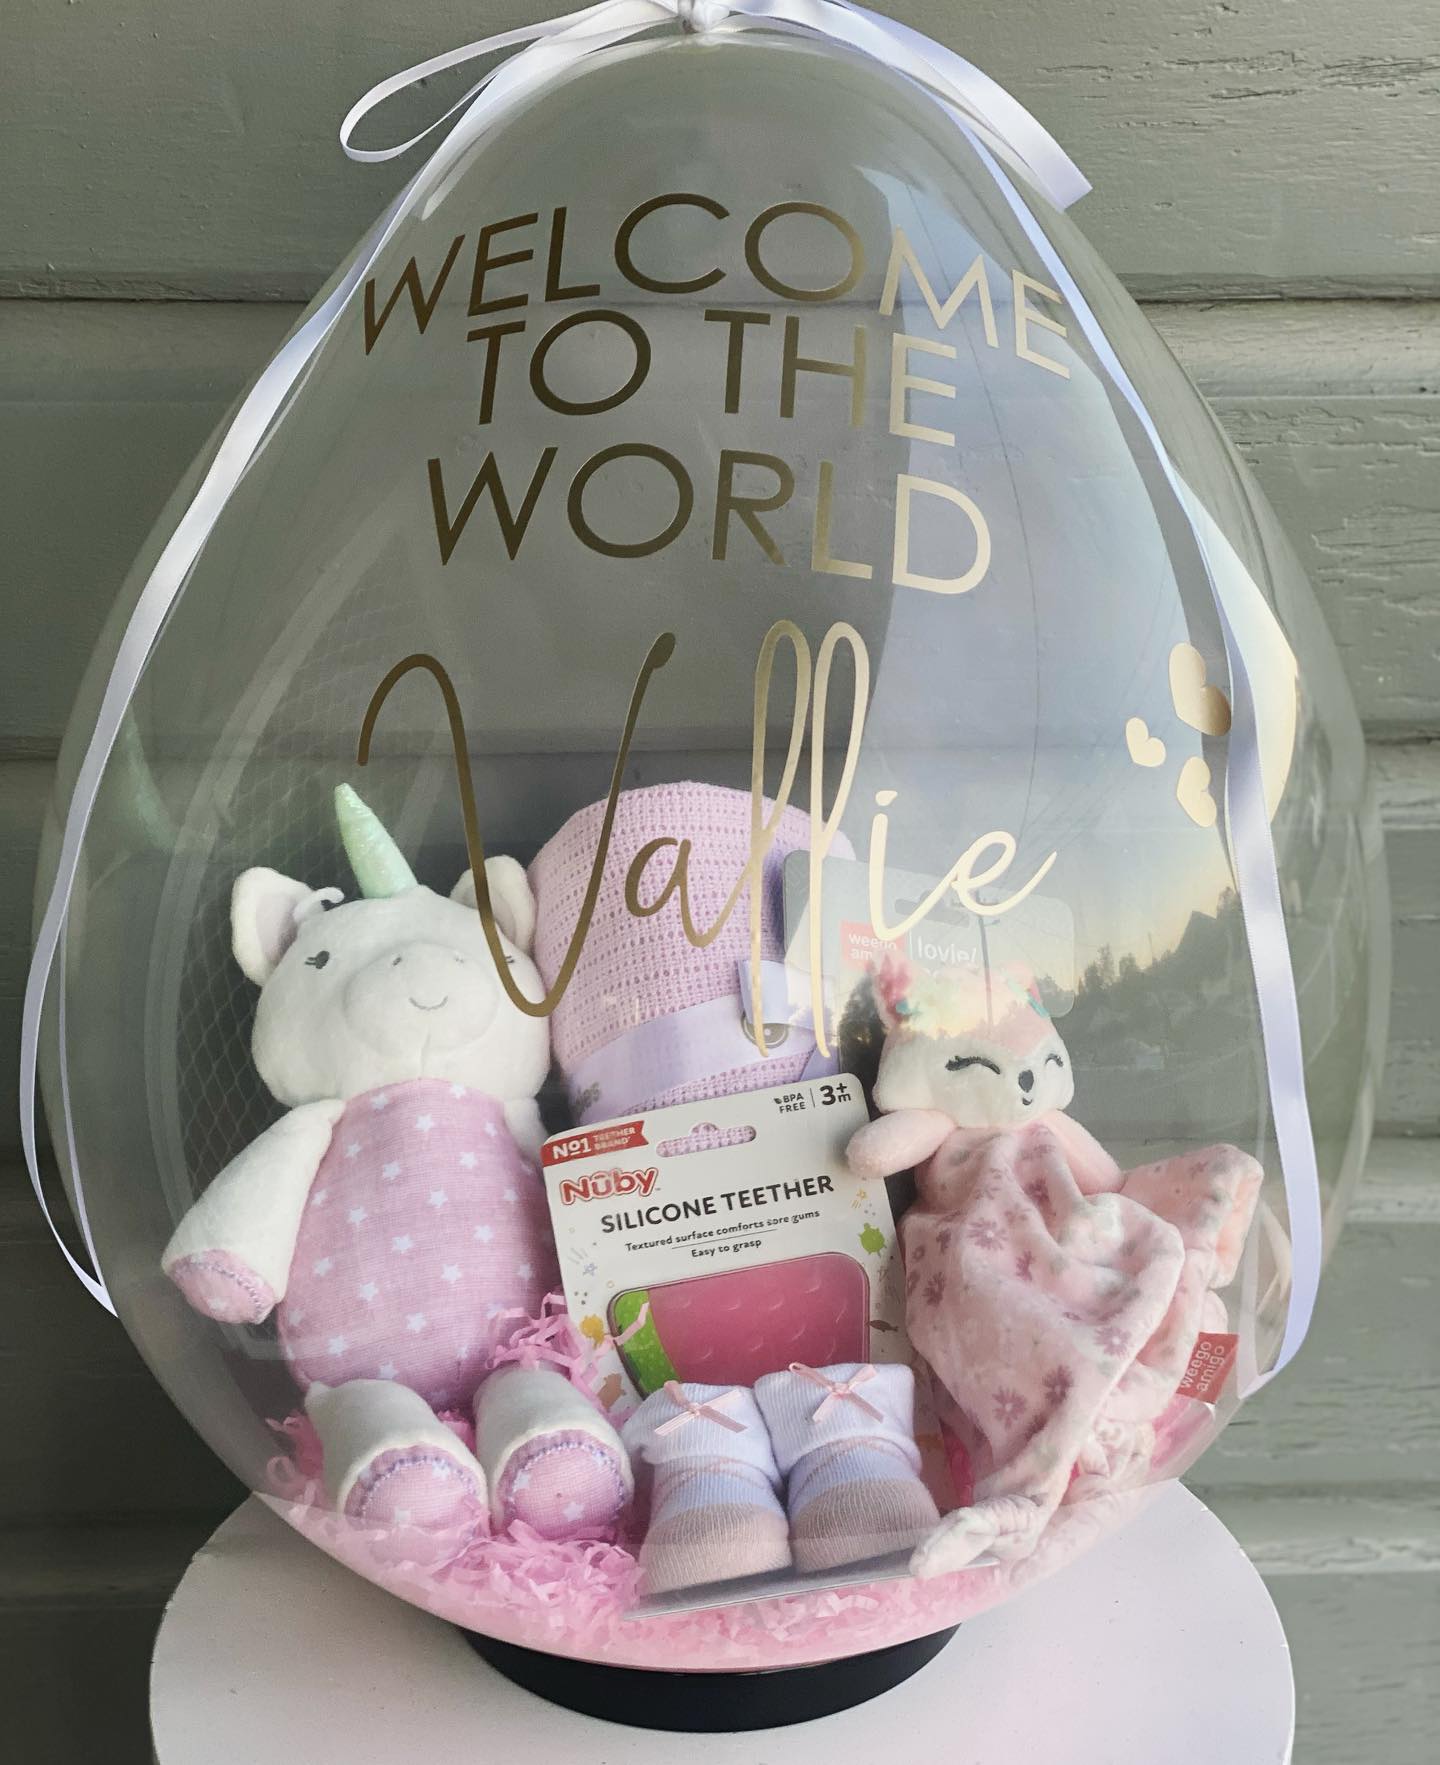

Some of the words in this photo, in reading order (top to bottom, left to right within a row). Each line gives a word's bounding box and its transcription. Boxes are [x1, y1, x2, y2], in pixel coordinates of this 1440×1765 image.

[362, 193, 1070, 379] WELCOME
[466, 309, 652, 426] TO
[703, 309, 957, 447] THE
[426, 442, 992, 595] WORLD
[357, 619, 1057, 1058] Vallie
[779, 1101, 807, 1114] FREE
[783, 1092, 805, 1103] BPA
[601, 1195, 718, 1234] SILICONE
[720, 1174, 835, 1211] TEETHER
[625, 1235, 673, 1252] Textured
[675, 1228, 715, 1244] surface
[716, 1219, 765, 1236] comforts
[767, 1214, 790, 1227] sore
[791, 1210, 821, 1225] gums
[691, 1246, 716, 1258] Easy
[718, 1243, 730, 1254] to
[732, 1239, 763, 1254] grasp
[1180, 1341, 1212, 1389] weego
[1196, 1345, 1226, 1392] amigo
